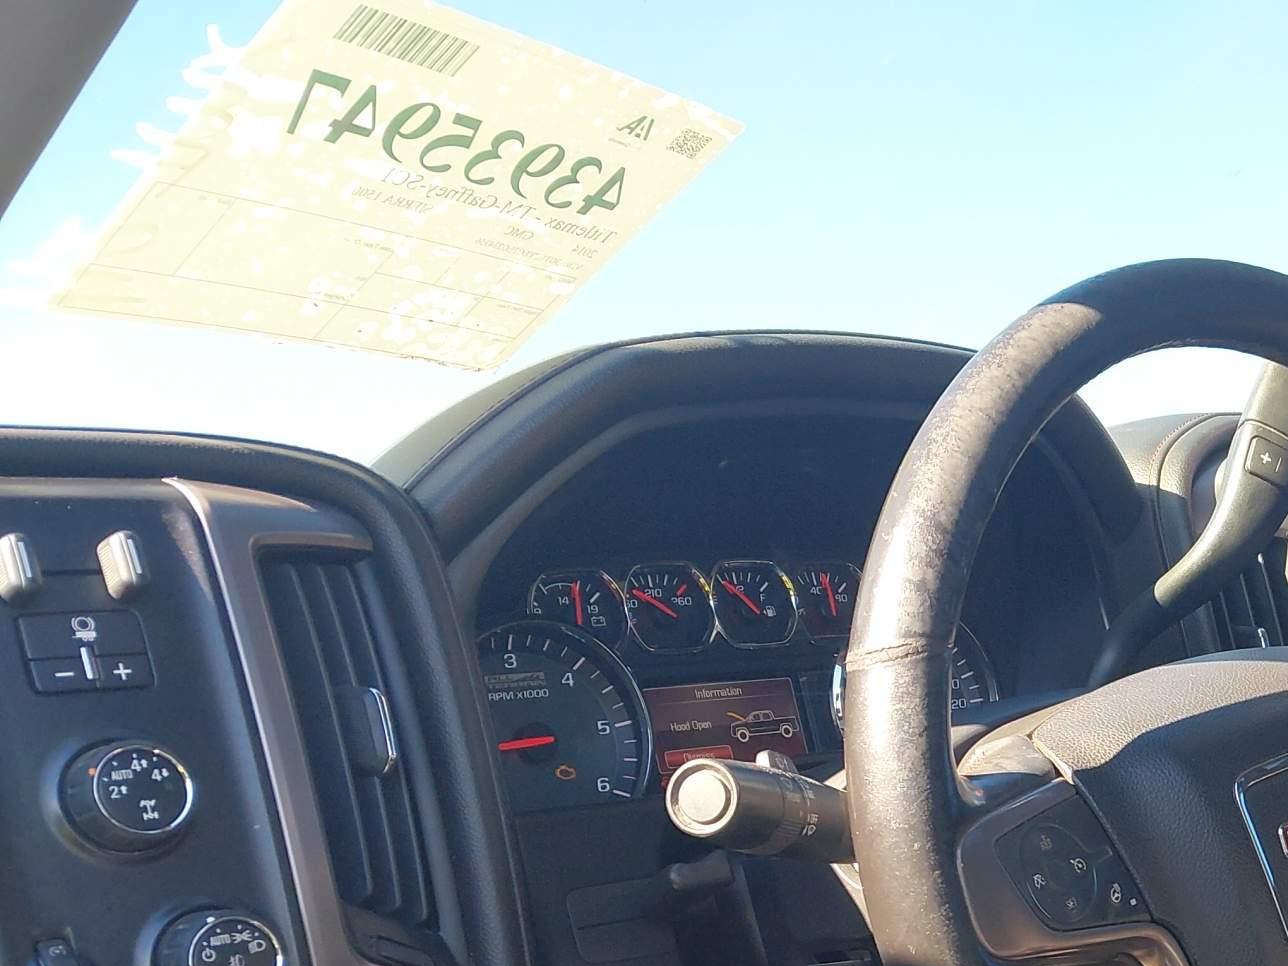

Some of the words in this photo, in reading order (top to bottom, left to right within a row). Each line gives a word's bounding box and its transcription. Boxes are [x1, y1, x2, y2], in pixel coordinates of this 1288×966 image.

[558, 595, 569, 606] 14
[587, 604, 599, 614] 19
[503, 653, 517, 669] 3
[561, 672, 575, 687] 4
[488, 691, 514, 702] RPM
[694, 686, 743, 699] Information
[951, 698, 967, 710] 20
[597, 720, 611, 735] 5
[670, 721, 691, 733] Hood
[692, 720, 713, 732] Open
[131, 760, 142, 772] 4
[111, 769, 134, 780] AUTO
[151, 769, 162, 782] 4
[597, 777, 611, 793] 6
[109, 785, 121, 799] 2
